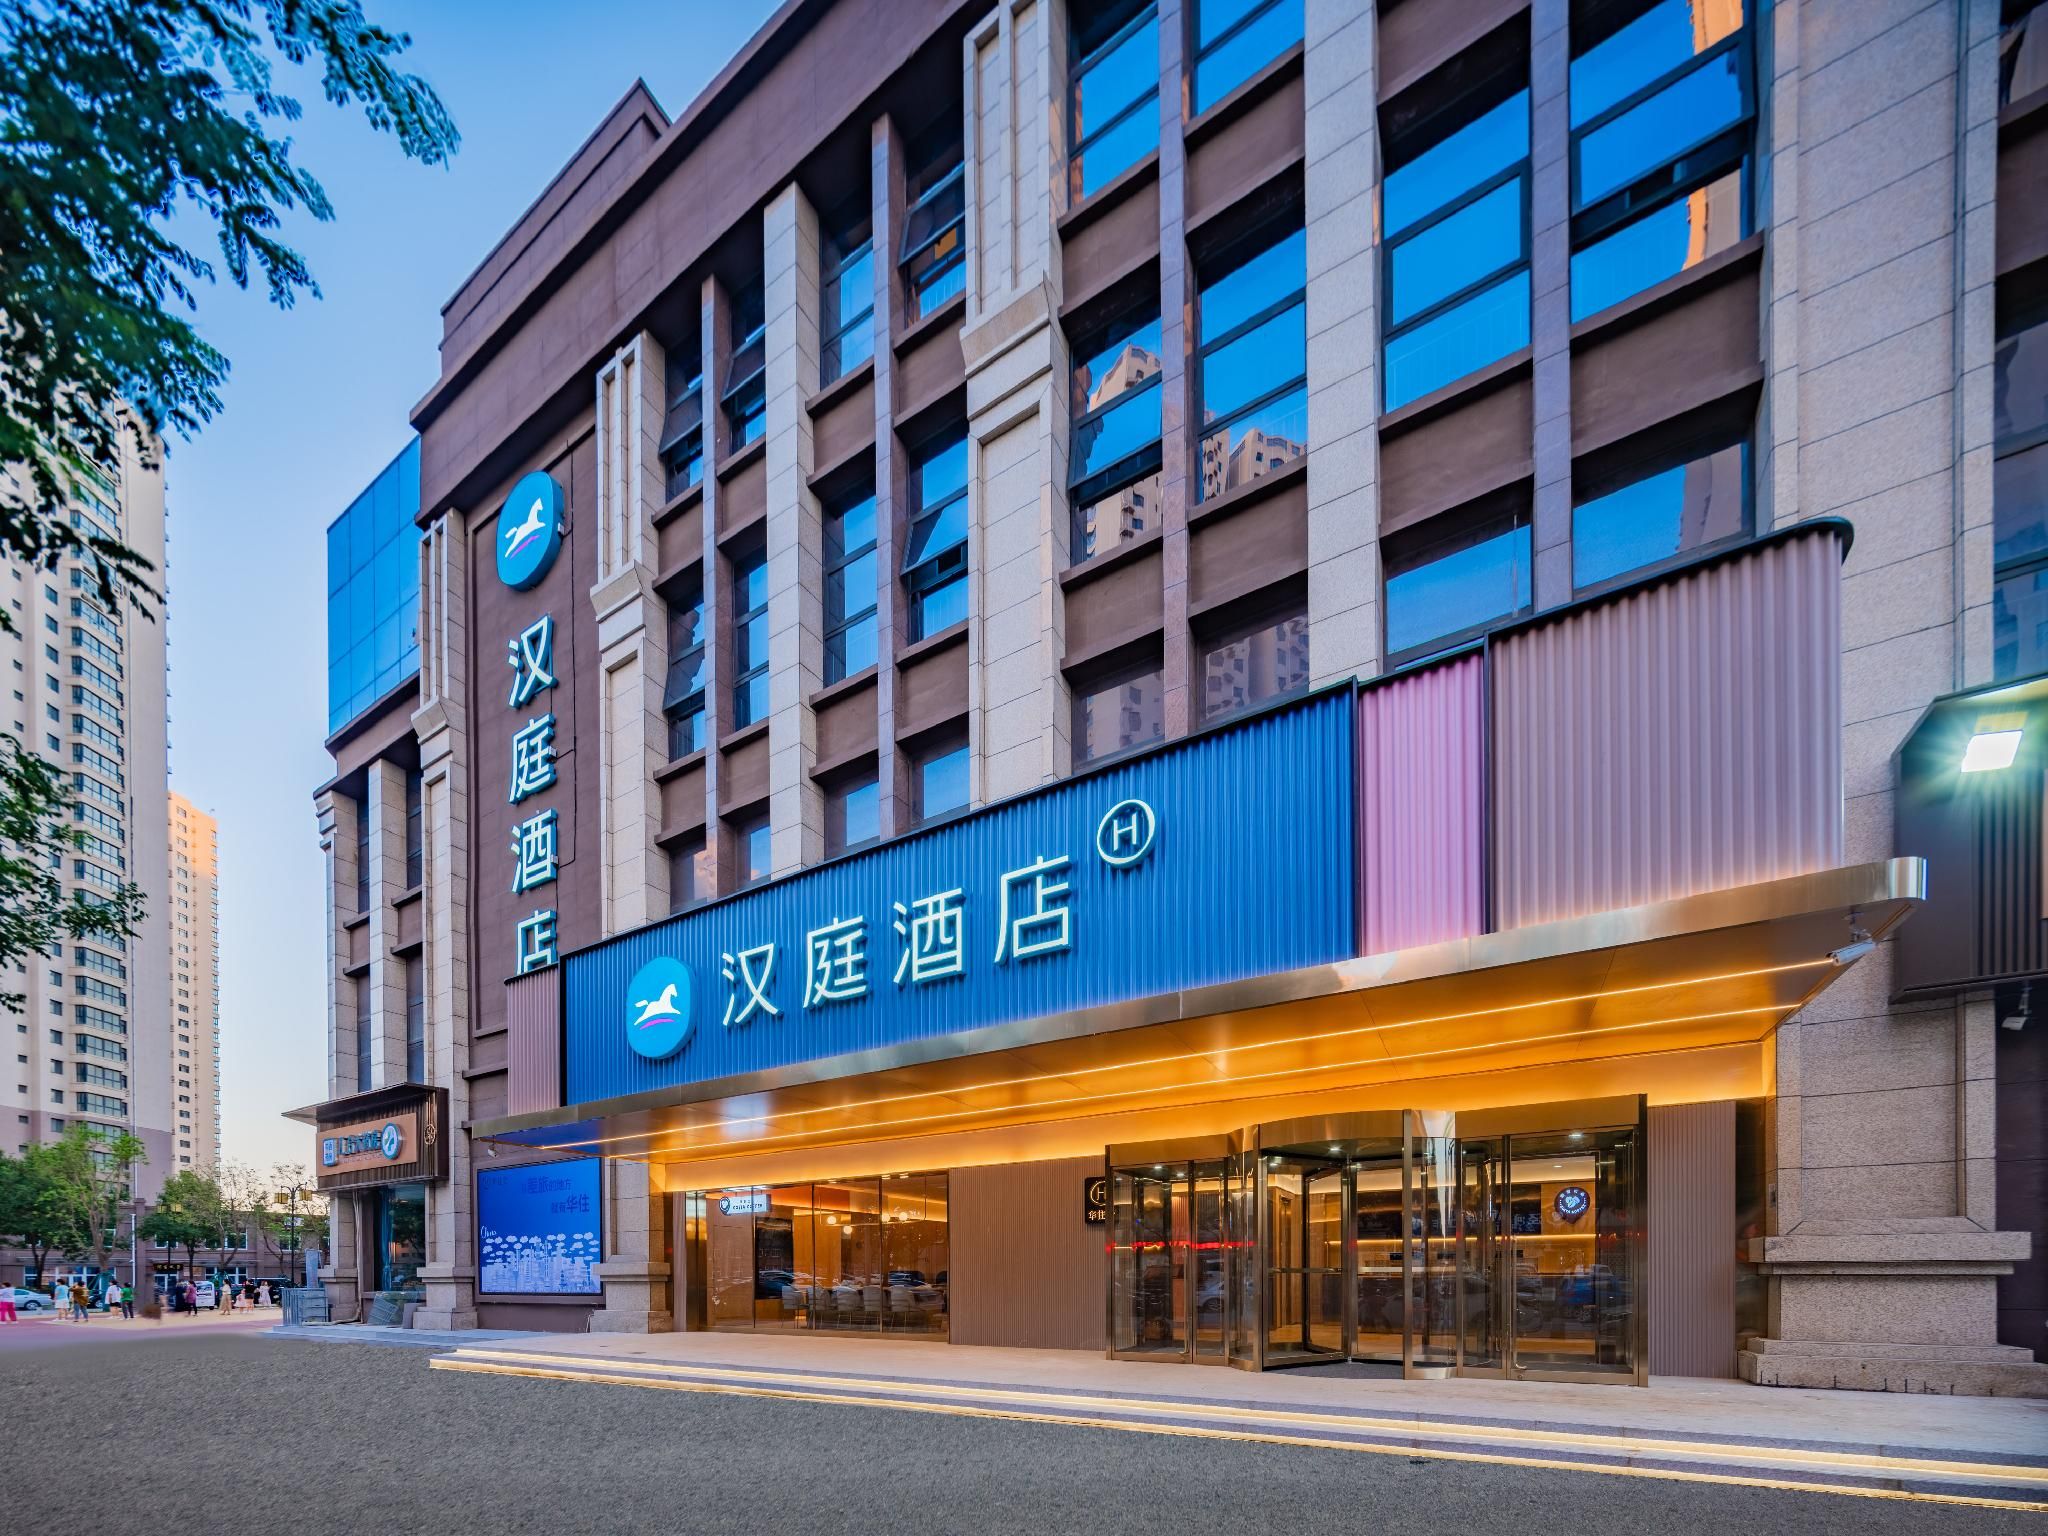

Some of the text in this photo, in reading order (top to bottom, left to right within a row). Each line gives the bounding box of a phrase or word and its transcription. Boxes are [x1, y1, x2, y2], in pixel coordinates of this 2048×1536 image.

[508, 614, 557, 975] 汉庭酒店
[721, 855, 1072, 1027] 汉庭酒店
